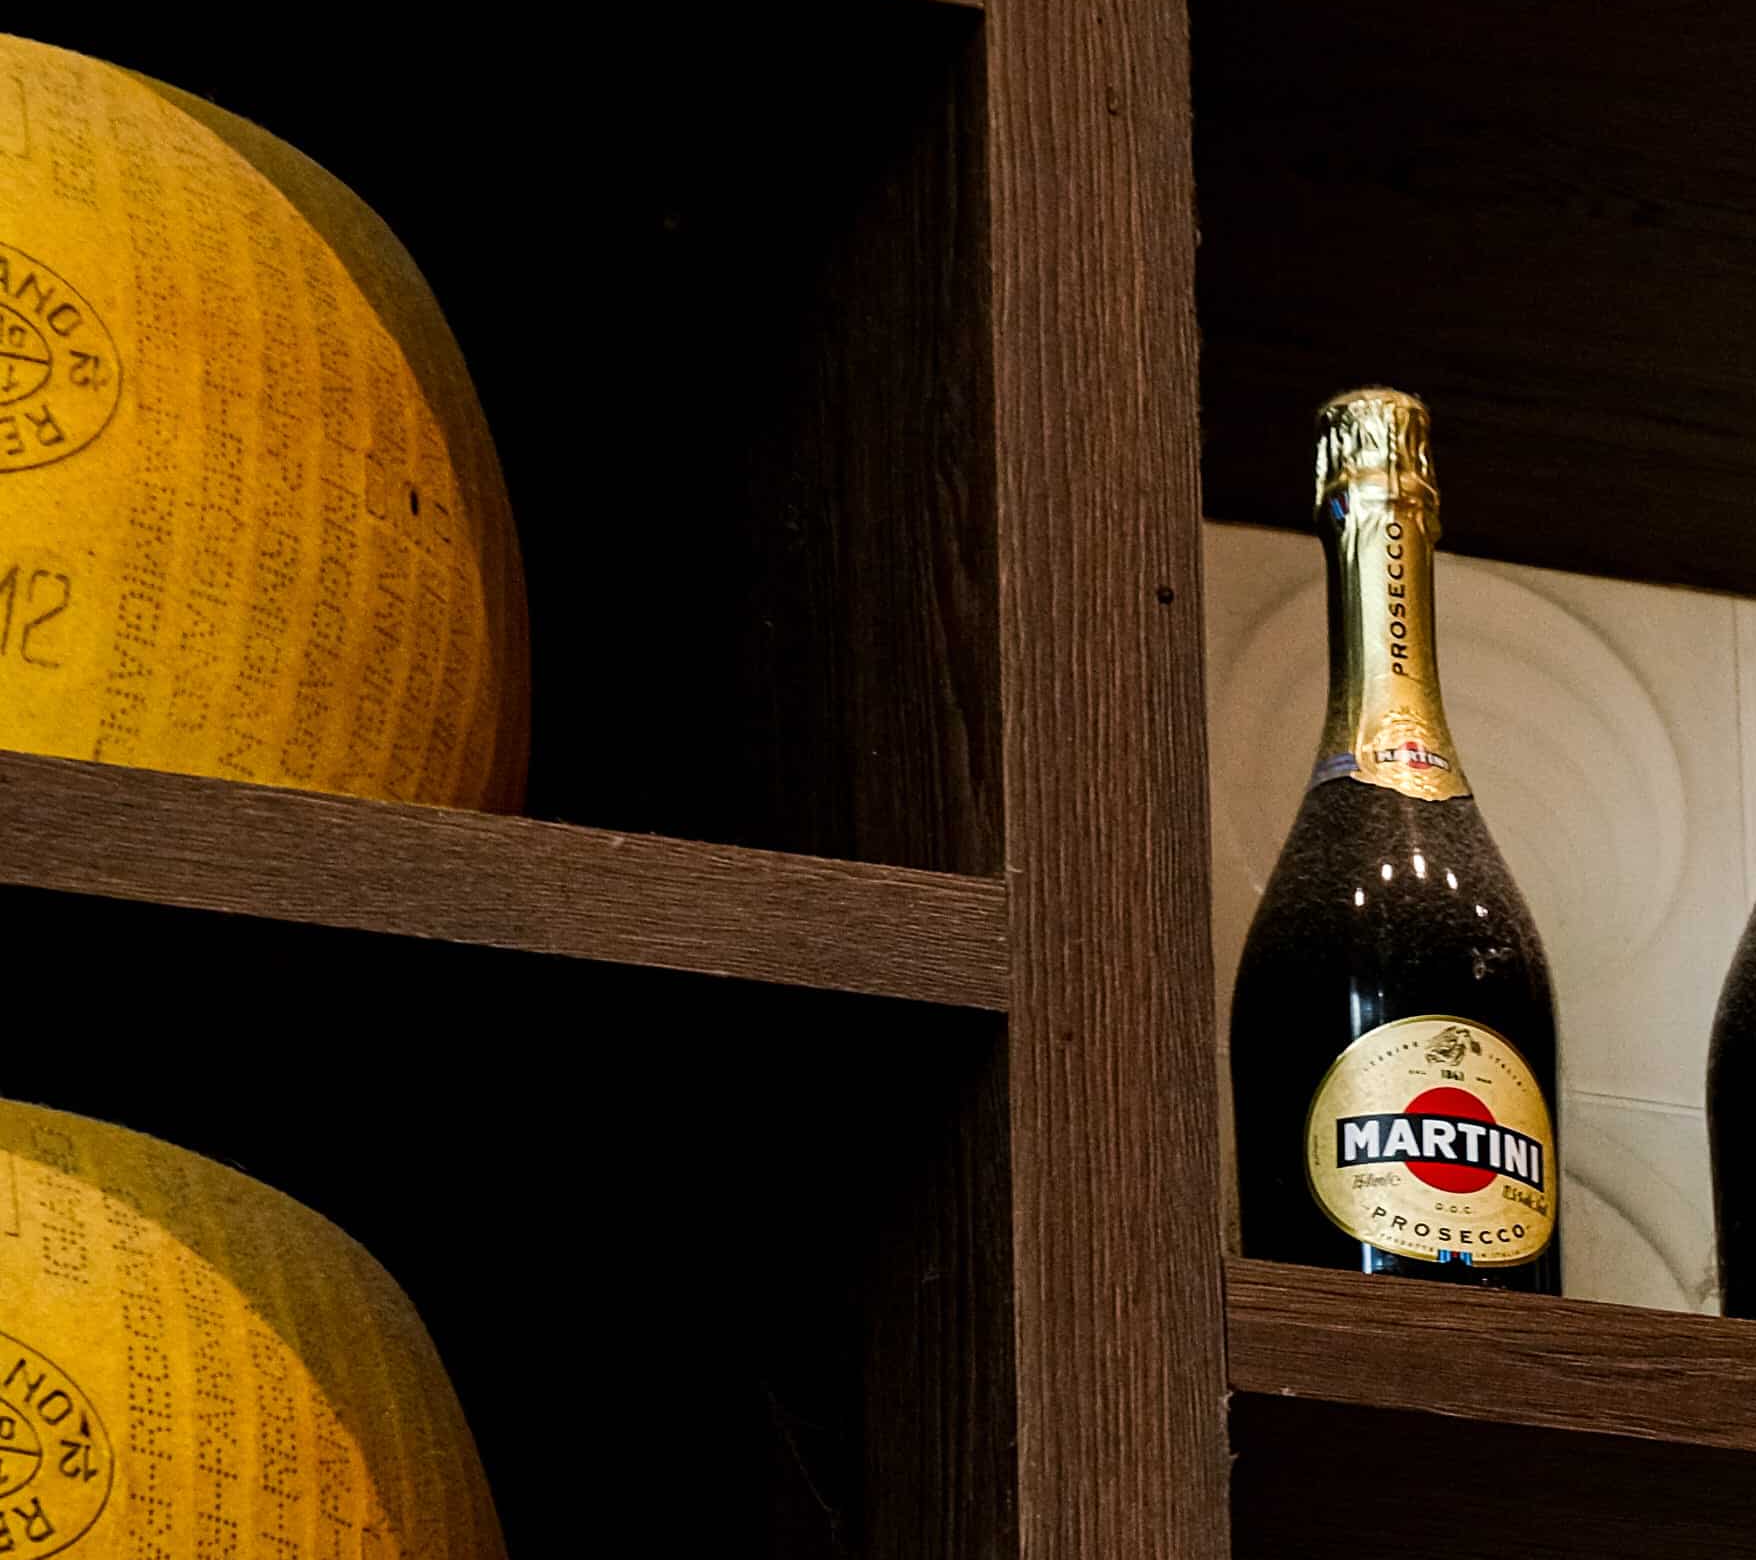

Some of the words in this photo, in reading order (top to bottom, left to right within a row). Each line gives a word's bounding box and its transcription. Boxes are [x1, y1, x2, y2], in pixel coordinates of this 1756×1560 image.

[1387, 522, 1408, 676] PROSECCO
[1344, 1119, 1539, 1183] MARTINI
[1372, 1207, 1525, 1244] PROSECCO
